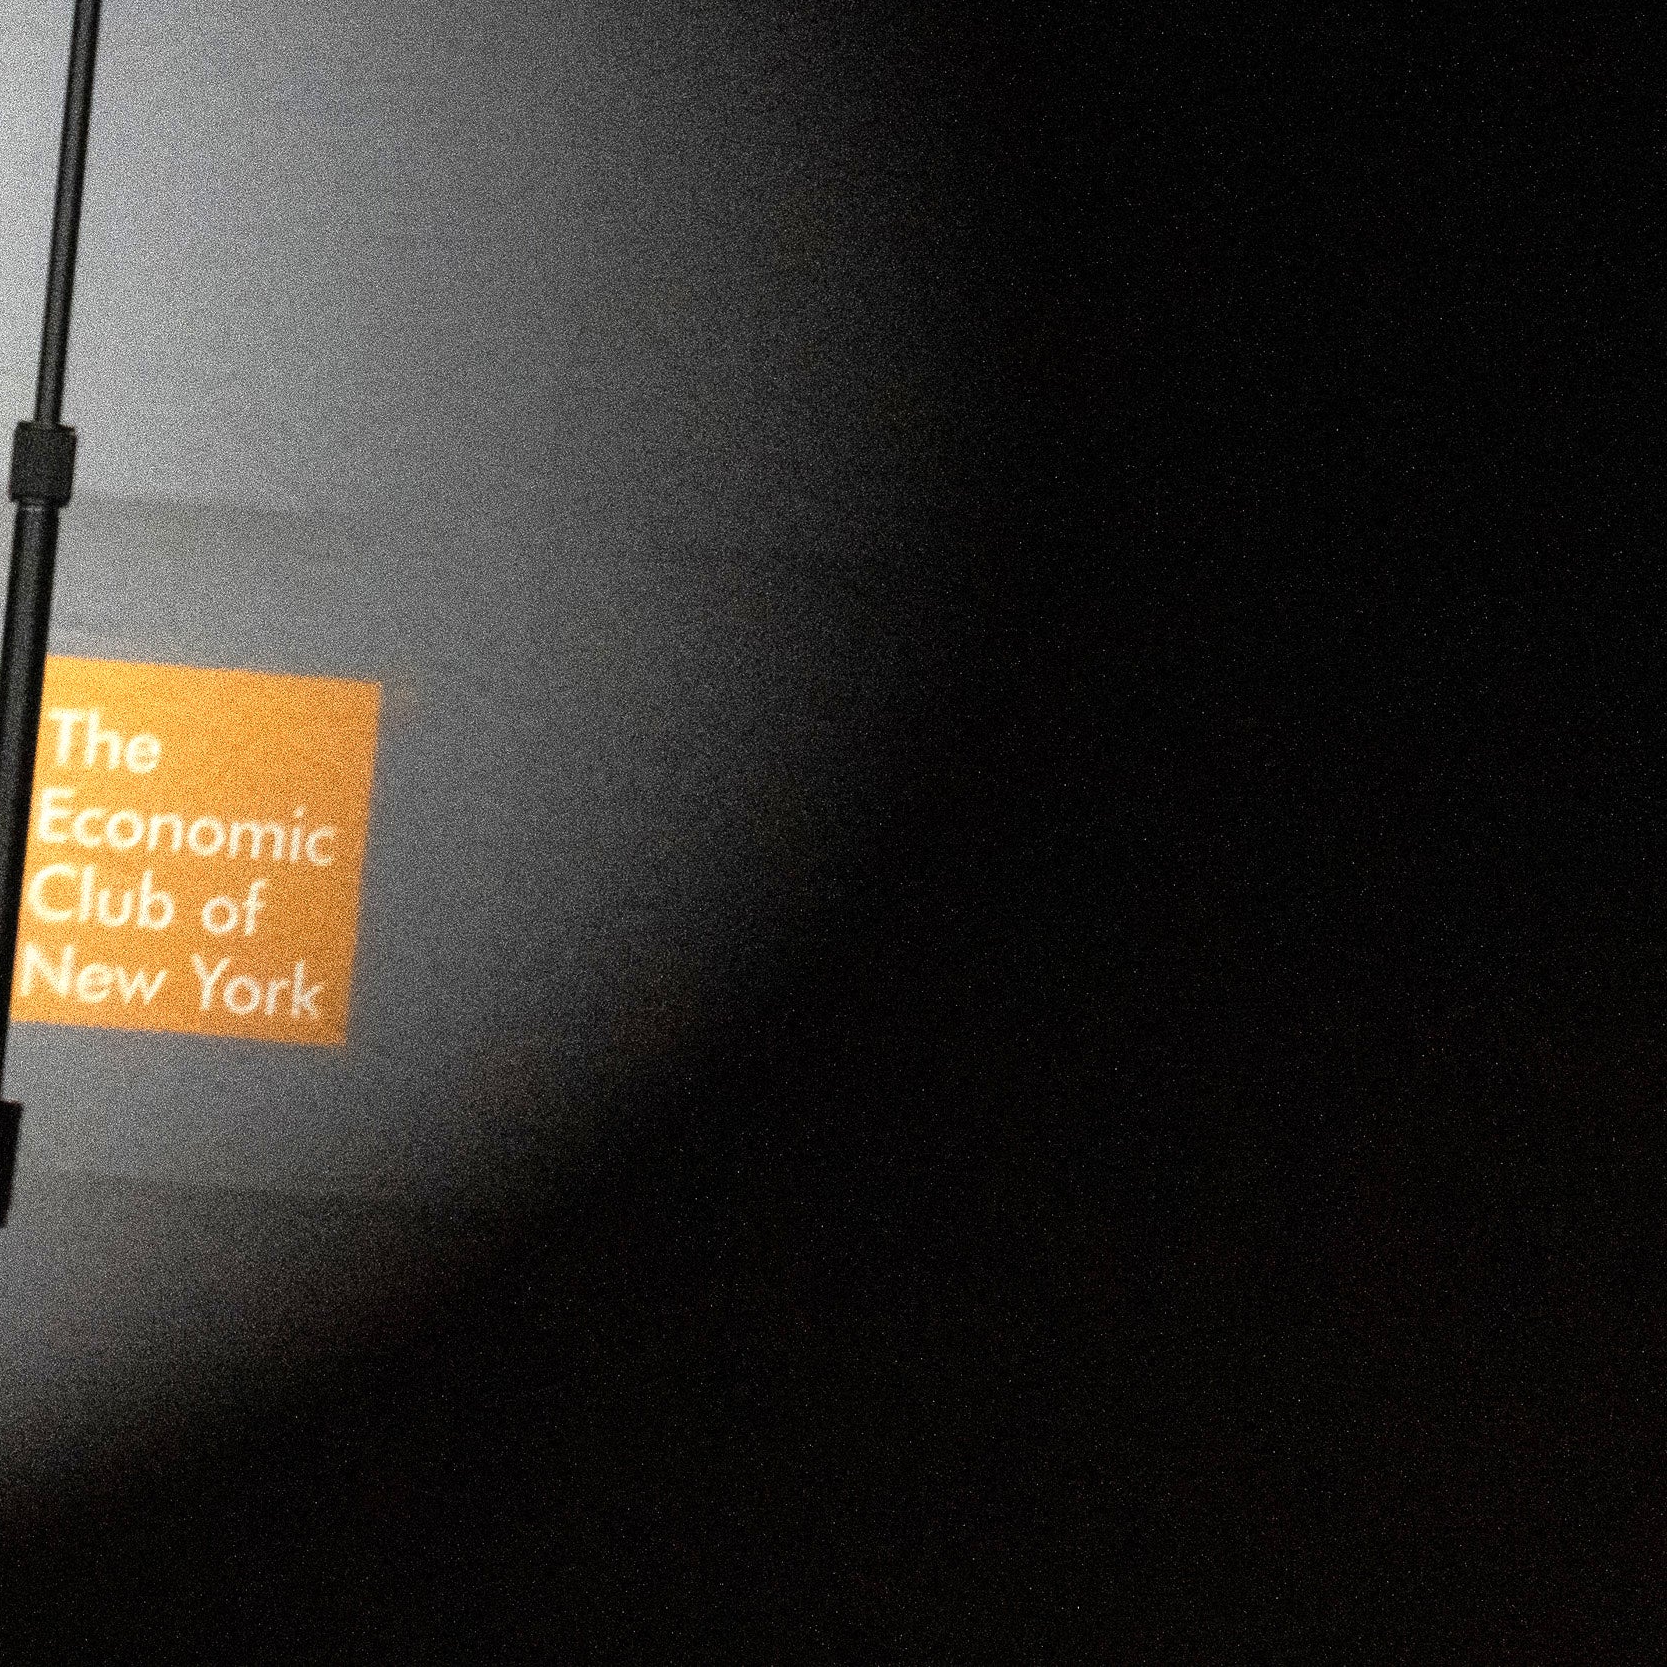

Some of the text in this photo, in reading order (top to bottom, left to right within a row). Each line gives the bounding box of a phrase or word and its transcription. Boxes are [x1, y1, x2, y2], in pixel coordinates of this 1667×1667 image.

[47, 707, 161, 773] The
[37, 786, 336, 866] Economic
[26, 863, 266, 936] Club of
[18, 943, 323, 1021] New York
